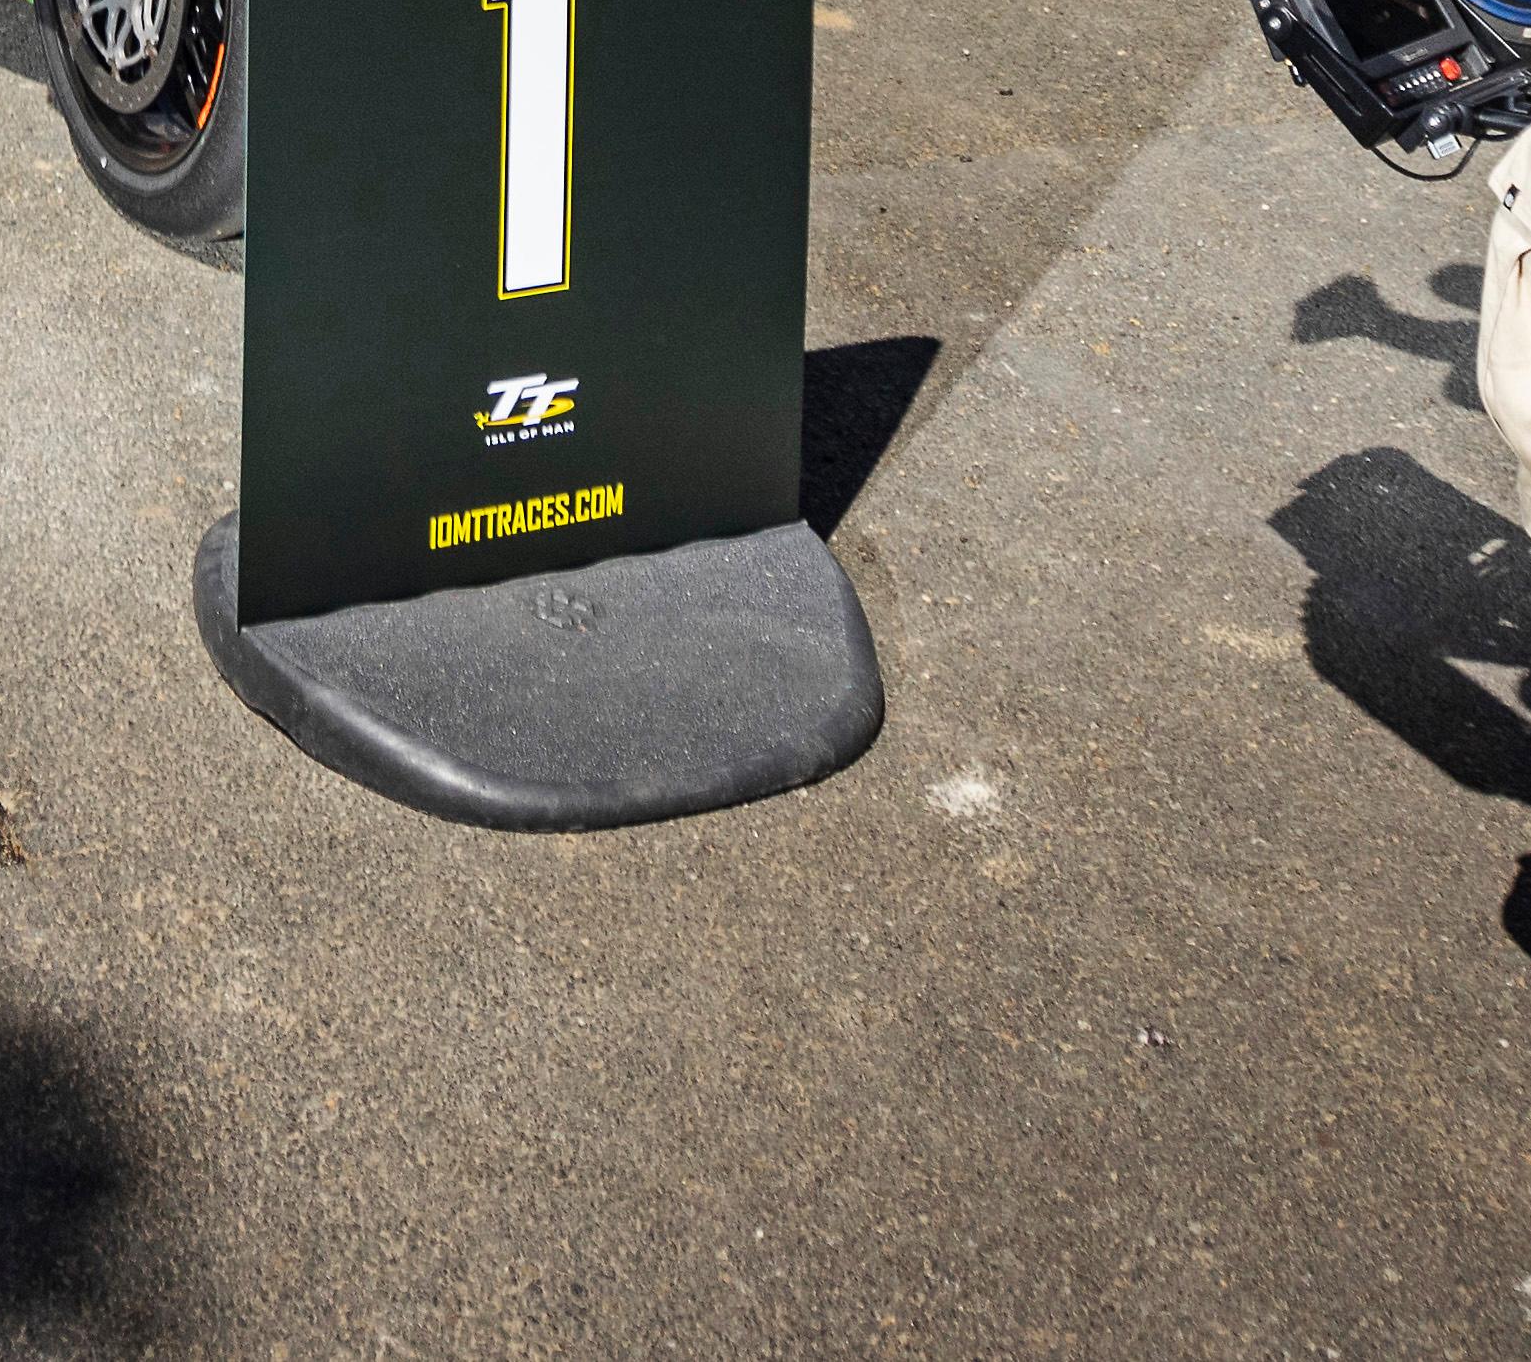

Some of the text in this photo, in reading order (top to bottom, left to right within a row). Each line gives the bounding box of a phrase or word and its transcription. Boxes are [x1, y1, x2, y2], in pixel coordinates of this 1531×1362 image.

[488, 374, 580, 427] TT
[485, 418, 576, 447] ISLE OF MAN
[429, 483, 624, 550] IOMTTRACES.COM
